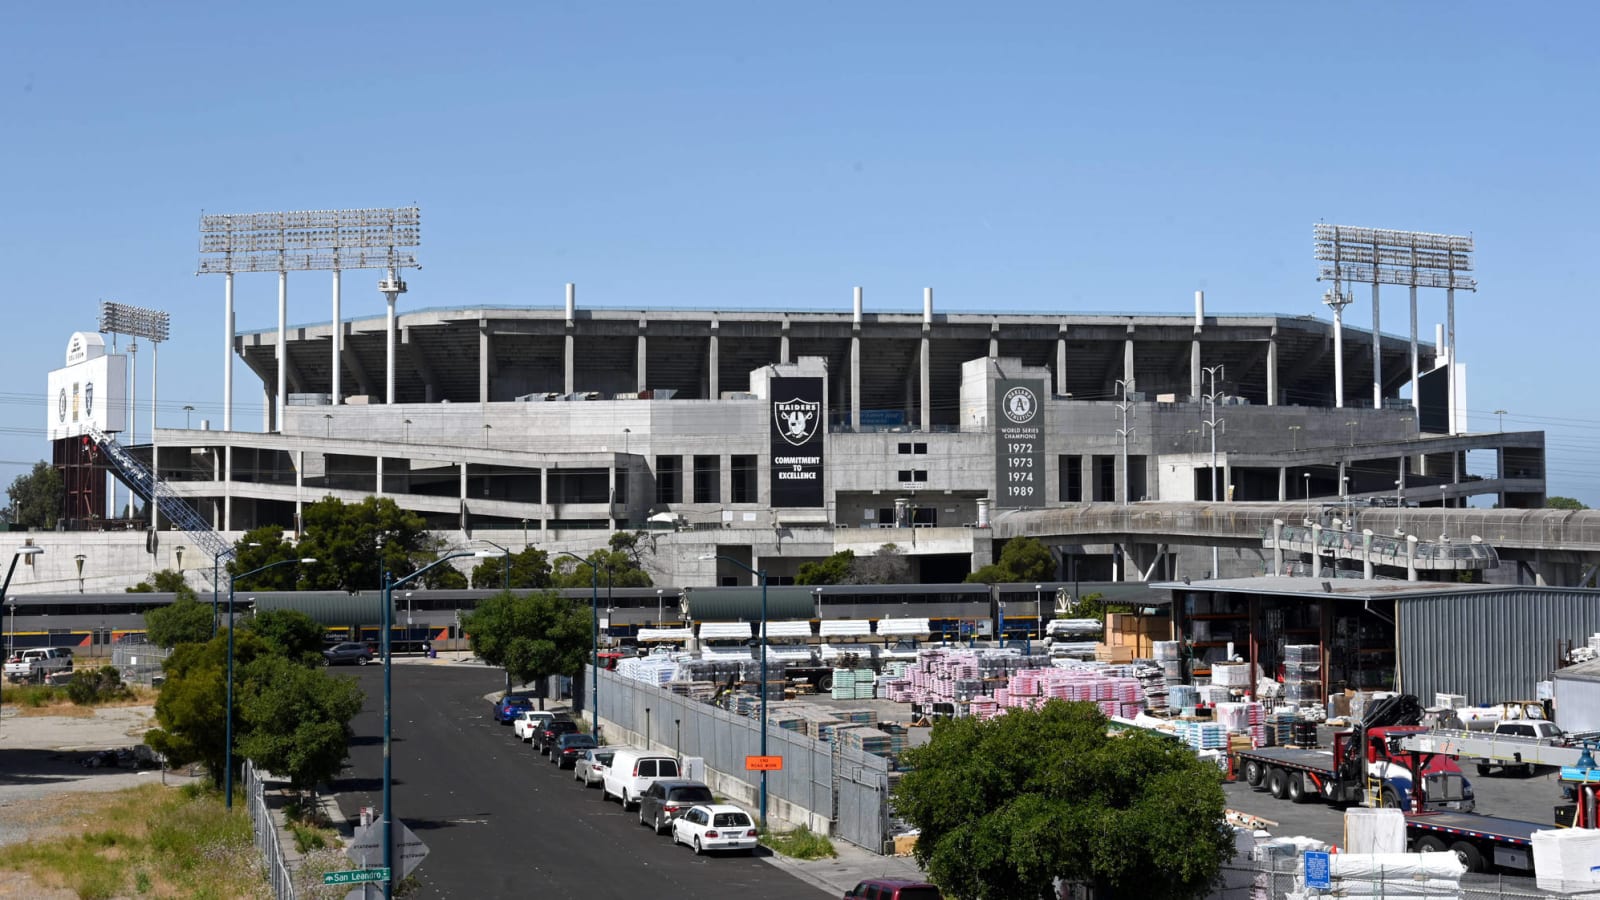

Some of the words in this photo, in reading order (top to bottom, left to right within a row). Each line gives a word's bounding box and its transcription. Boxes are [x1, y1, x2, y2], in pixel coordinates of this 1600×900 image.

[1008, 389, 1032, 400] OAKLAND
[1007, 410, 1033, 422] ATHLETICS
[1008, 443, 1033, 453] 1972
[775, 457, 820, 465] COMMITMENT
[1008, 457, 1033, 468] 1973
[793, 464, 802, 472] TO
[778, 472, 816, 480] EXCELLENCE
[1008, 472, 1034, 482] 1974
[1008, 486, 1034, 497] 1989
[334, 873, 348, 882] San
[351, 871, 381, 881] Leandro
